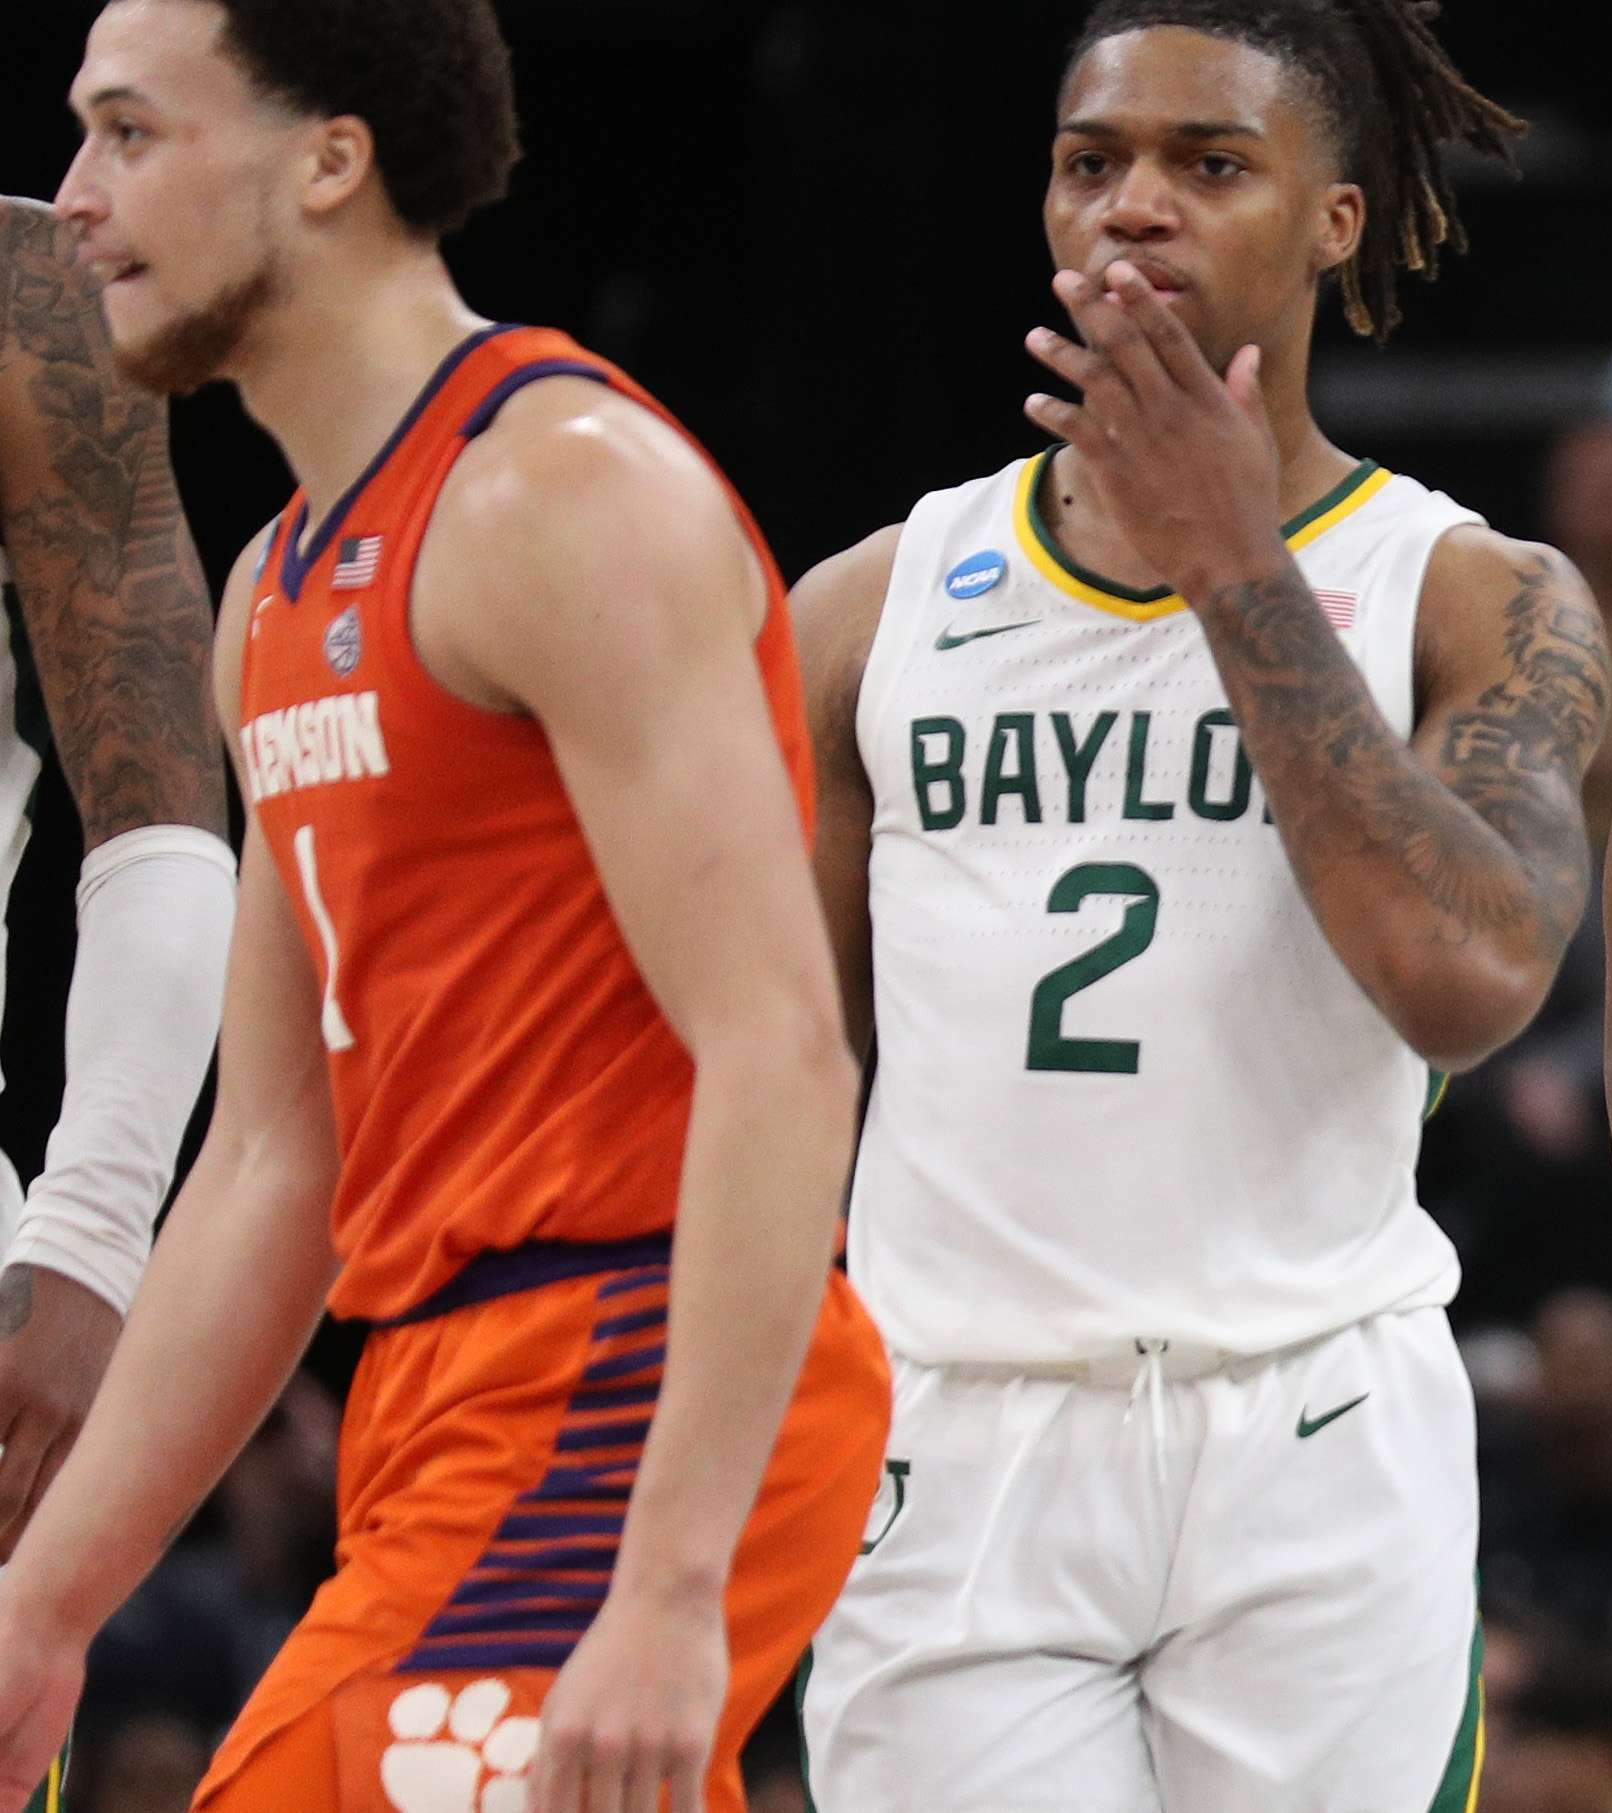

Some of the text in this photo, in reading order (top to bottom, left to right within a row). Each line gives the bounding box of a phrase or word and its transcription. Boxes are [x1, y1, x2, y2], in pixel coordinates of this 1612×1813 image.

[240, 690, 390, 801] LEMSON
[911, 710, 1276, 832] BAYLO
[294, 825, 355, 1051] 1
[1026, 861, 1160, 1074] 2
